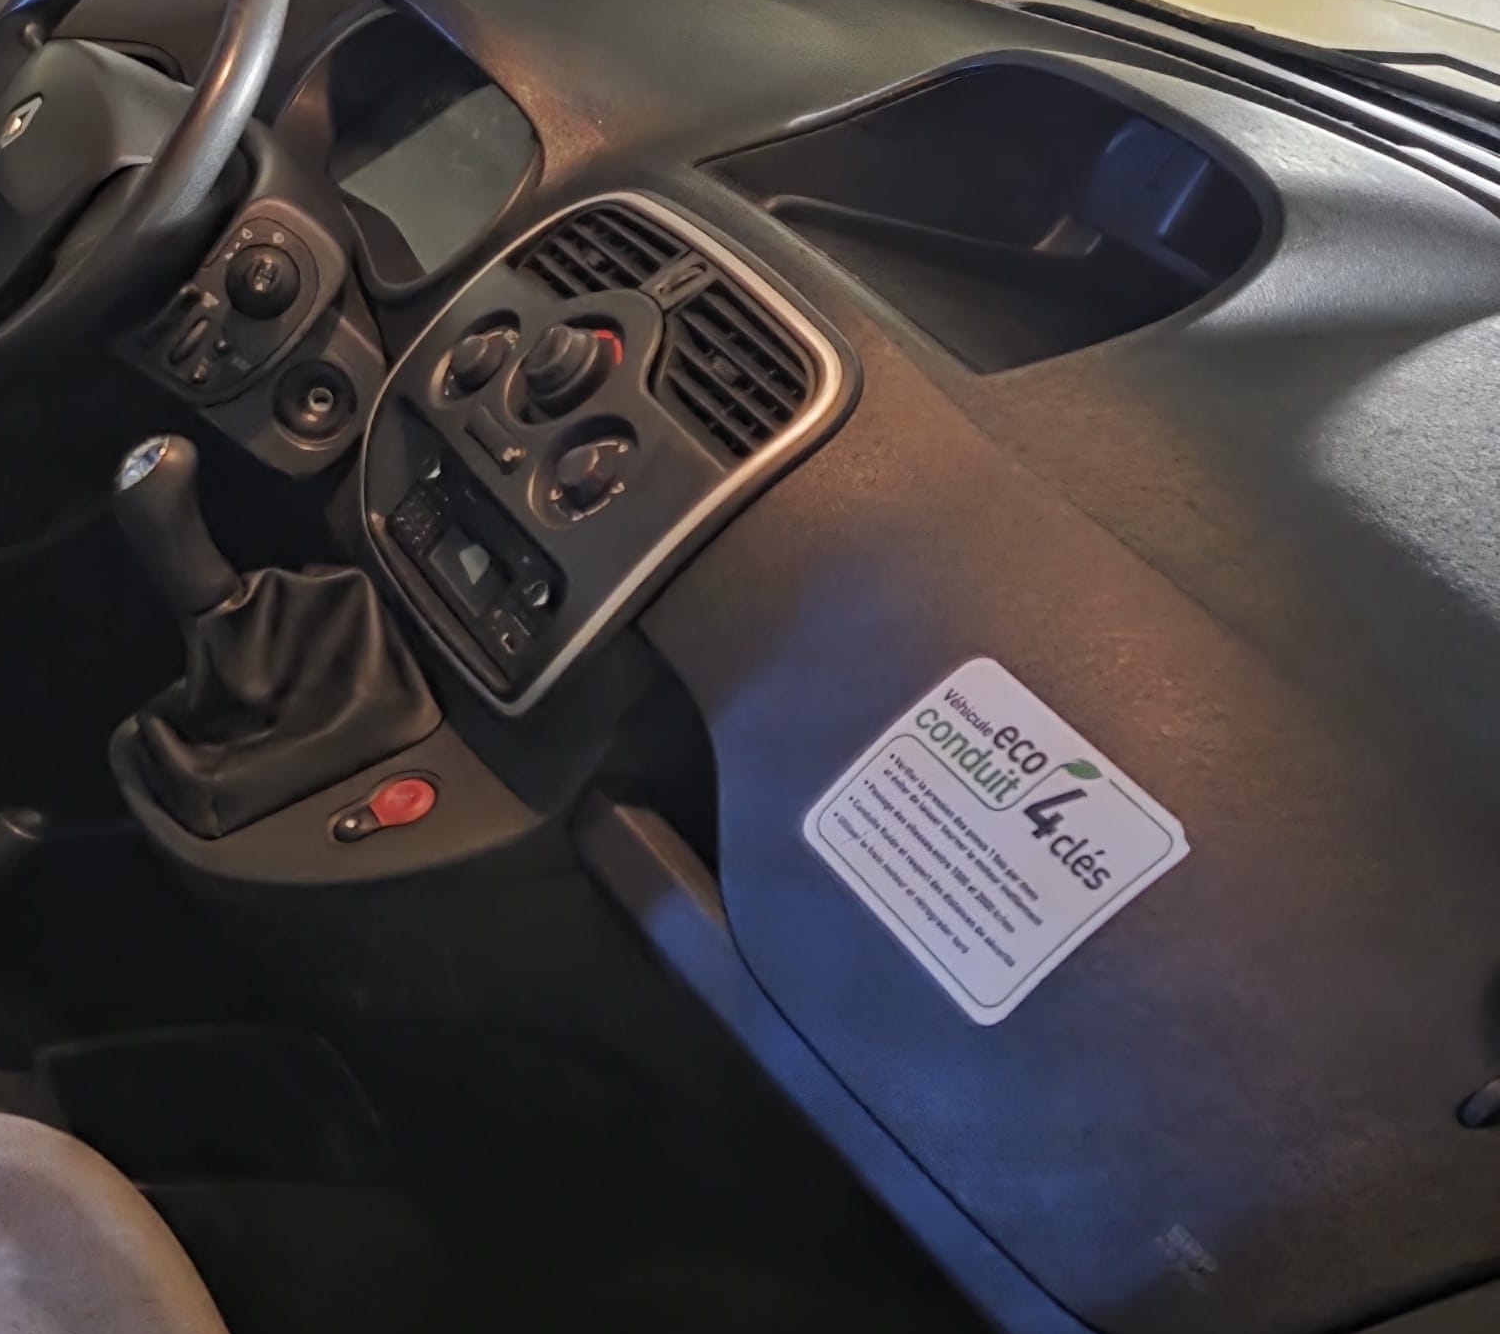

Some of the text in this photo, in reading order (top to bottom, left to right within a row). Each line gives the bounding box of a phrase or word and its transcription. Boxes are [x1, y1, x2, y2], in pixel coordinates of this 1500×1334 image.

[915, 707, 1020, 802] conduit
[943, 688, 1047, 774] Véhicule eco
[1022, 788, 1110, 890] 4 clés
